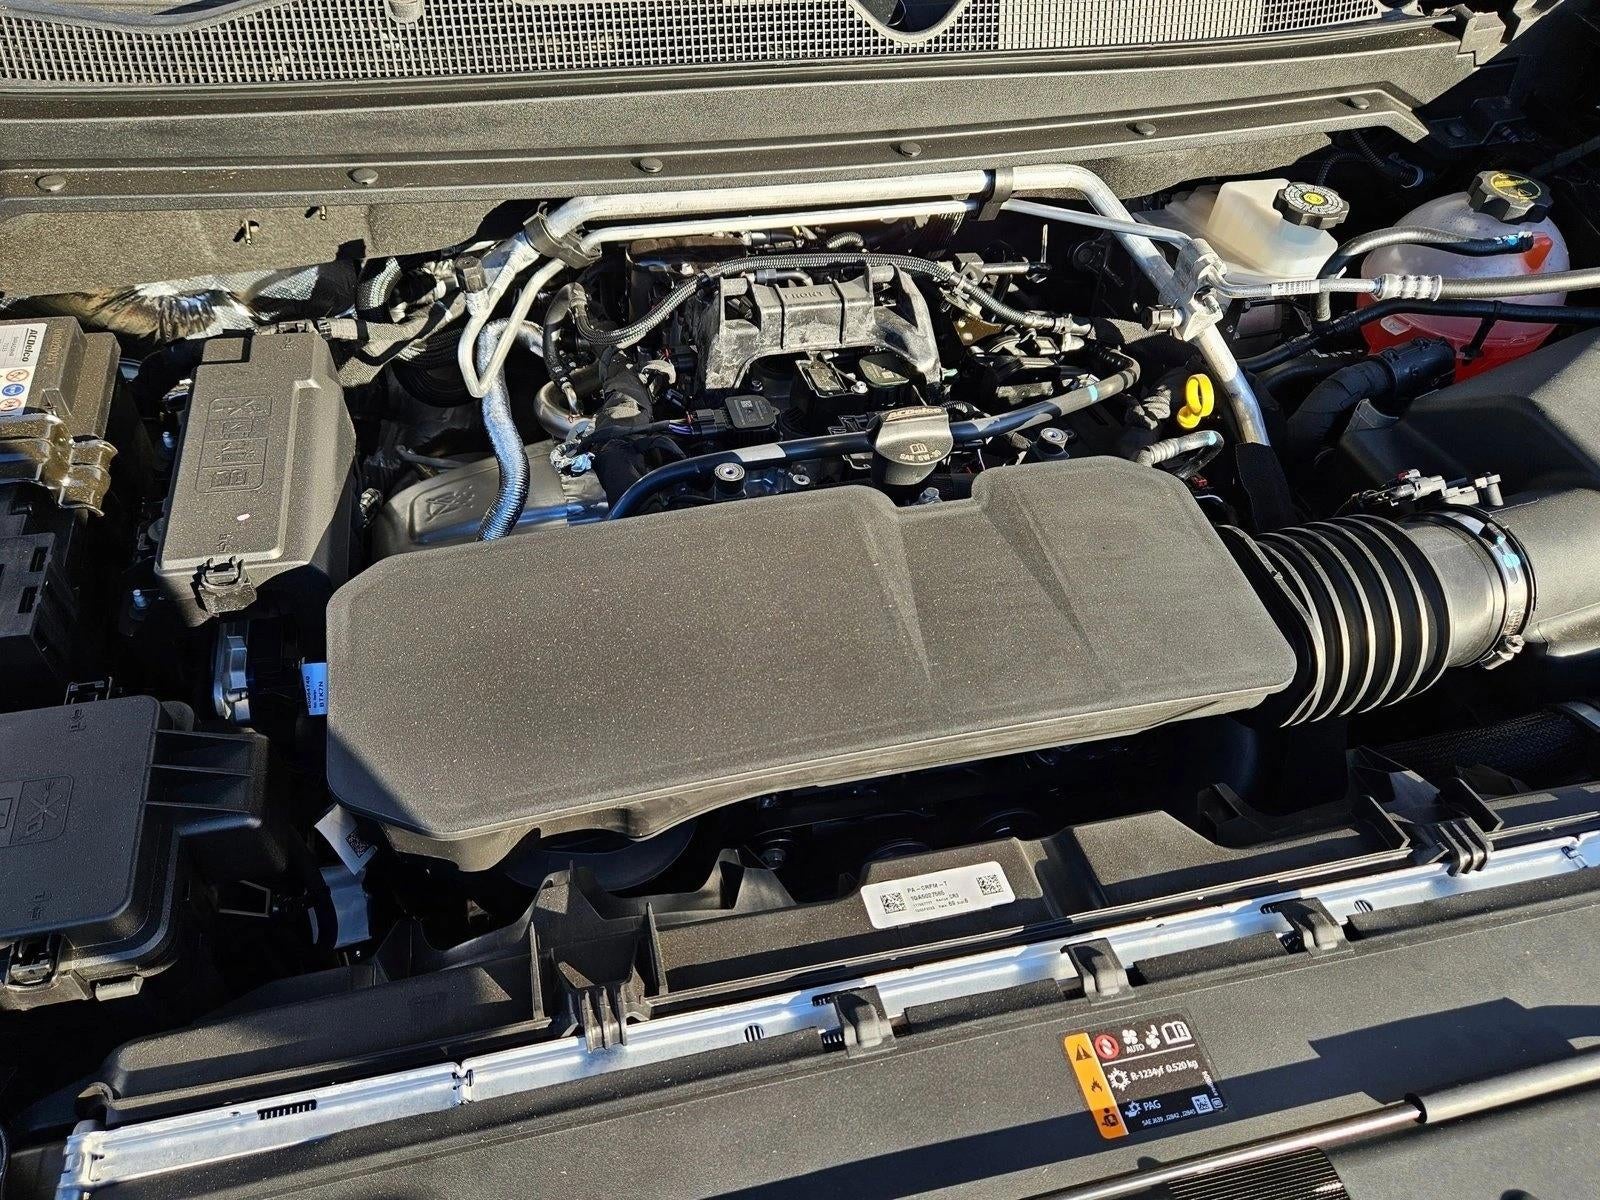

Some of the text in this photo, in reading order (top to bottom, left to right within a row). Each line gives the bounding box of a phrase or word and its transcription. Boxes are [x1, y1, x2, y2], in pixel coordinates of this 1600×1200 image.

[22, 329, 38, 362] ACDelco
[900, 453, 915, 461] SAE
[1126, 1044, 1145, 1054] AUTO
[1130, 1059, 1199, 1081] R-1234yf 0.520 kg
[1143, 1100, 1162, 1111] PAG
[1142, 1118, 1153, 1127] SAE
